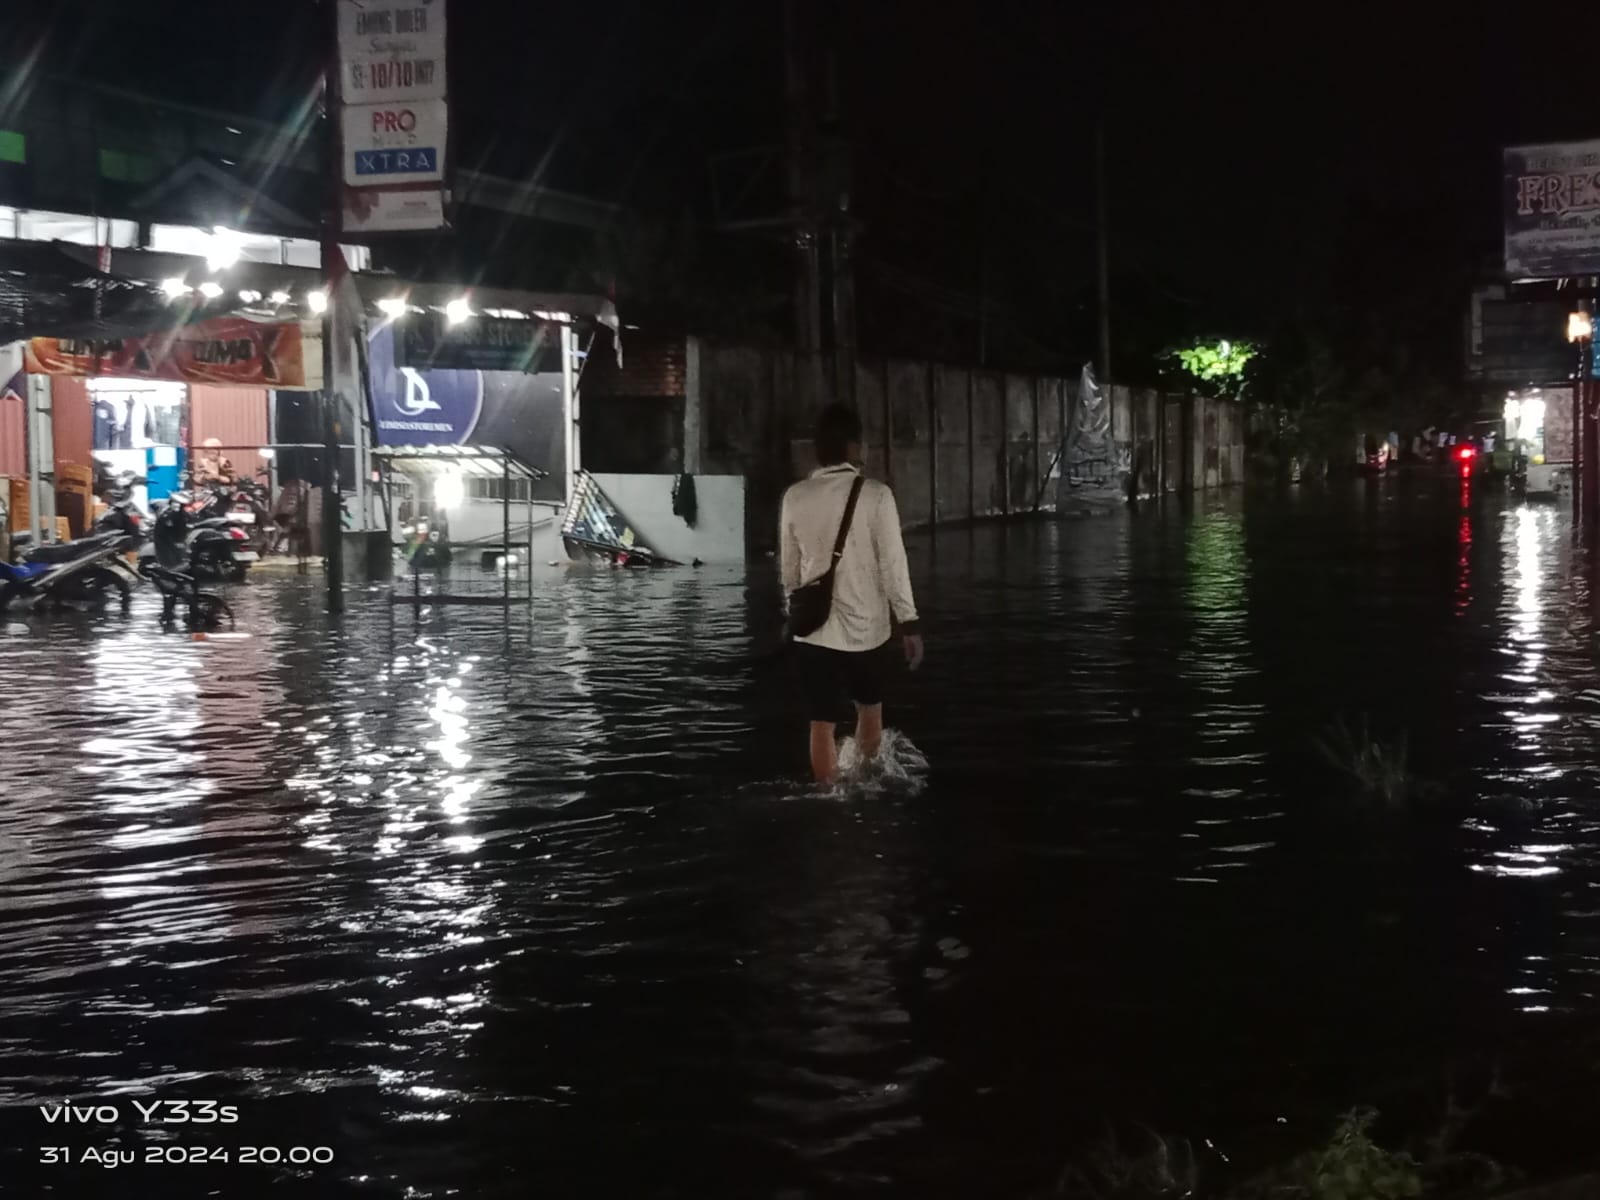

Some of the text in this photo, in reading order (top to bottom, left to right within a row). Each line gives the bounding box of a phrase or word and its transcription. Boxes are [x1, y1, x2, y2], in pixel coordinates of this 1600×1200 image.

[370, 61, 412, 89] 10/10
[372, 109, 416, 132] PRO
[361, 152, 430, 170] XTRA
